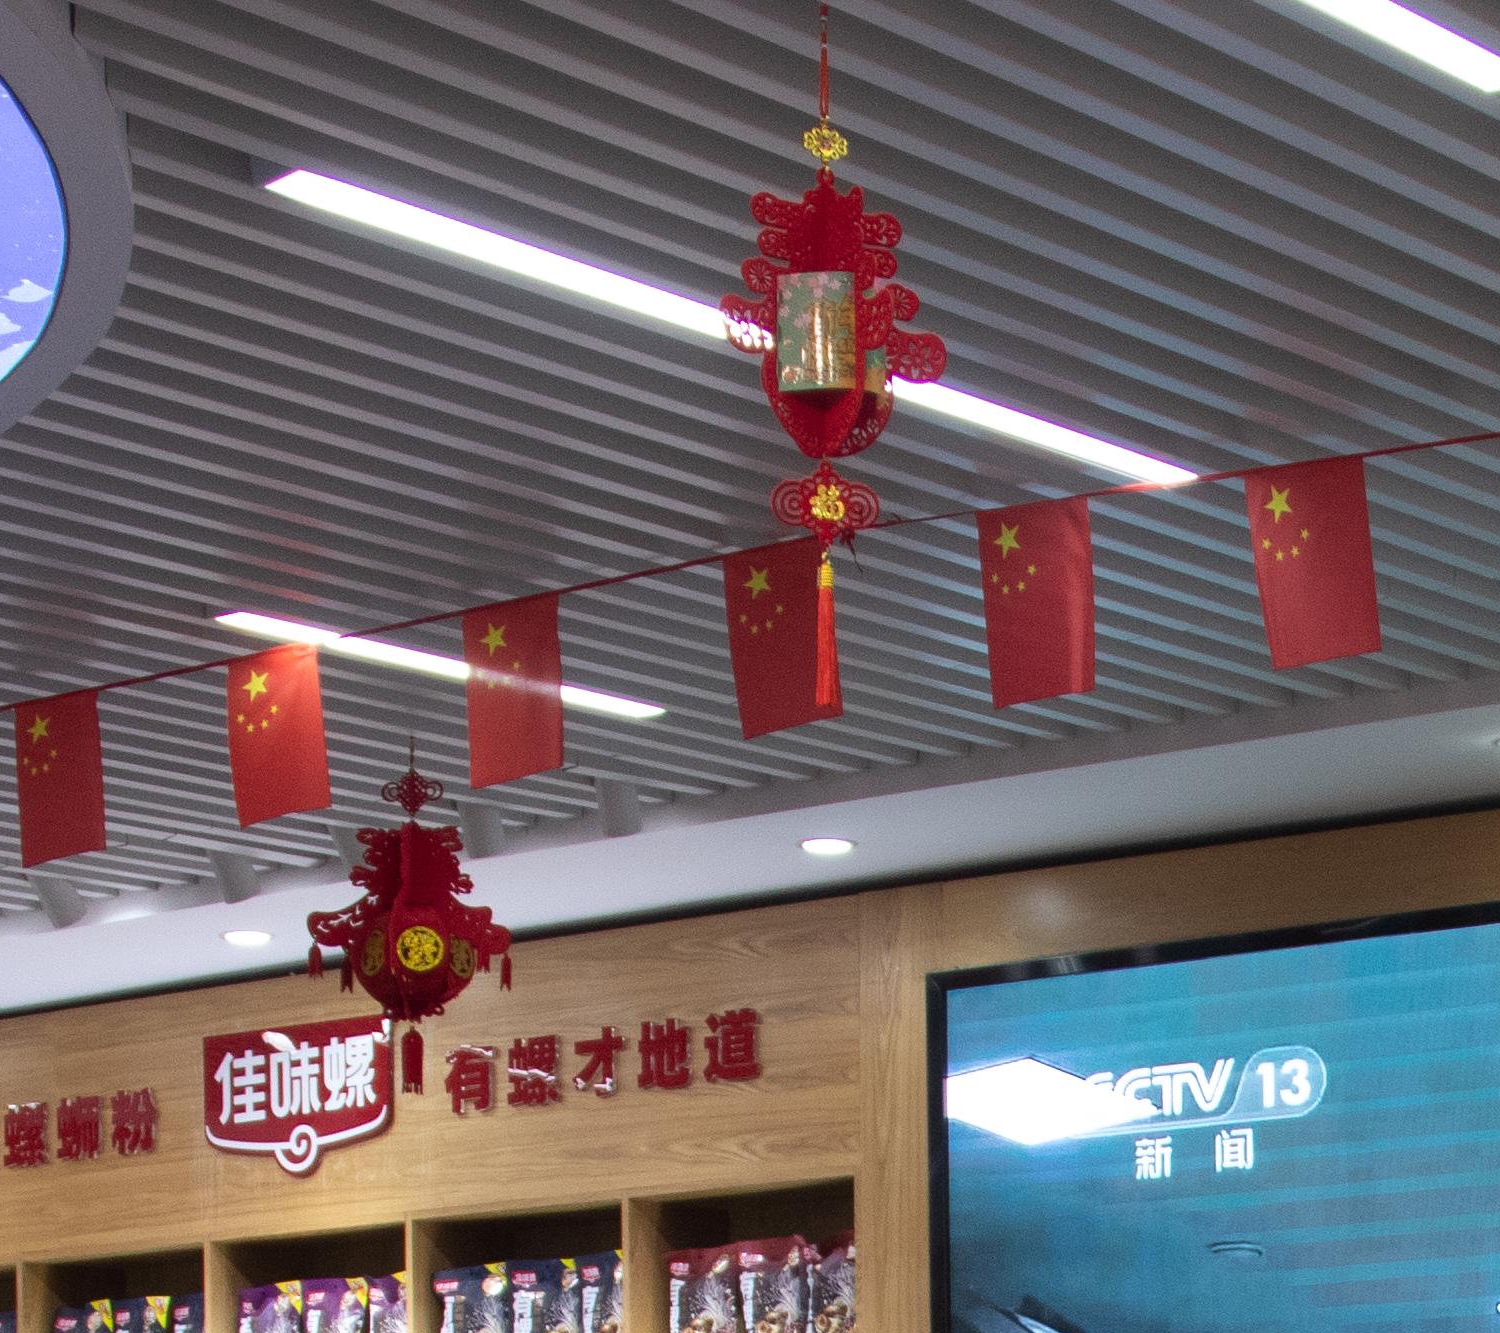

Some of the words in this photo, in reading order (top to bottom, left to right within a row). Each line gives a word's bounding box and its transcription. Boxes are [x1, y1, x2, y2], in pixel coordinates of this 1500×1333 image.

[213, 1035, 377, 1127] 佳味螺
[445, 1008, 763, 1116] 有螺才地道
[1256, 1058, 1312, 1109] 13
